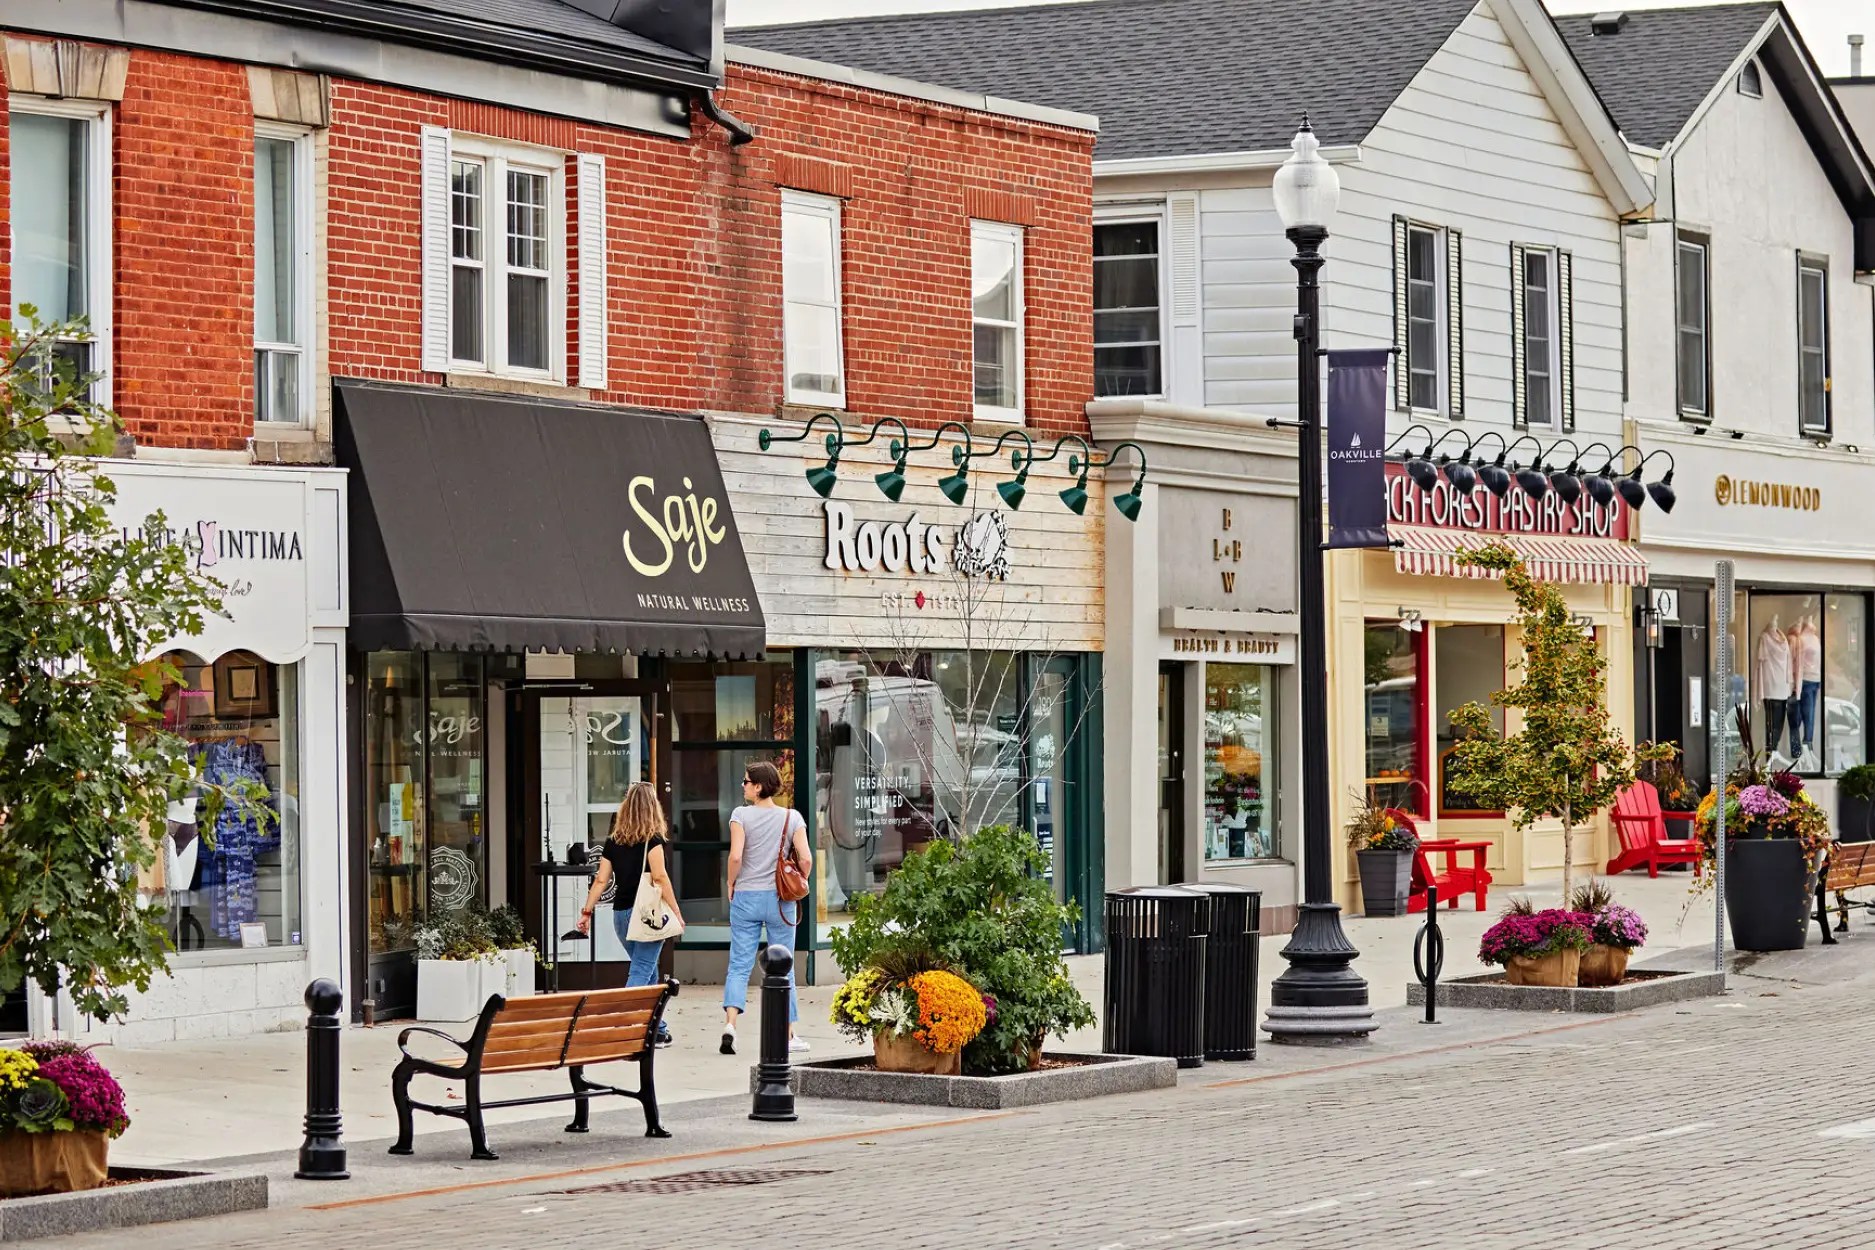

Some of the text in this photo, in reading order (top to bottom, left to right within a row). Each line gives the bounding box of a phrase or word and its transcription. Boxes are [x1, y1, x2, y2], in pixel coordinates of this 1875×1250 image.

[1330, 449, 1382, 460] OAKVILLE
[1421, 479, 1491, 530] FOREST
[1571, 492, 1620, 537] SHOP
[1732, 479, 1821, 512] LEMONWOOD
[622, 475, 727, 578] Saje
[824, 500, 944, 574] Roots
[218, 529, 304, 561] INTIMA
[637, 593, 750, 613] NATURAL WELLNESS
[1173, 638, 1280, 654] HEALTH & BEAUTY
[855, 794, 904, 810] SIMPLIFIED
